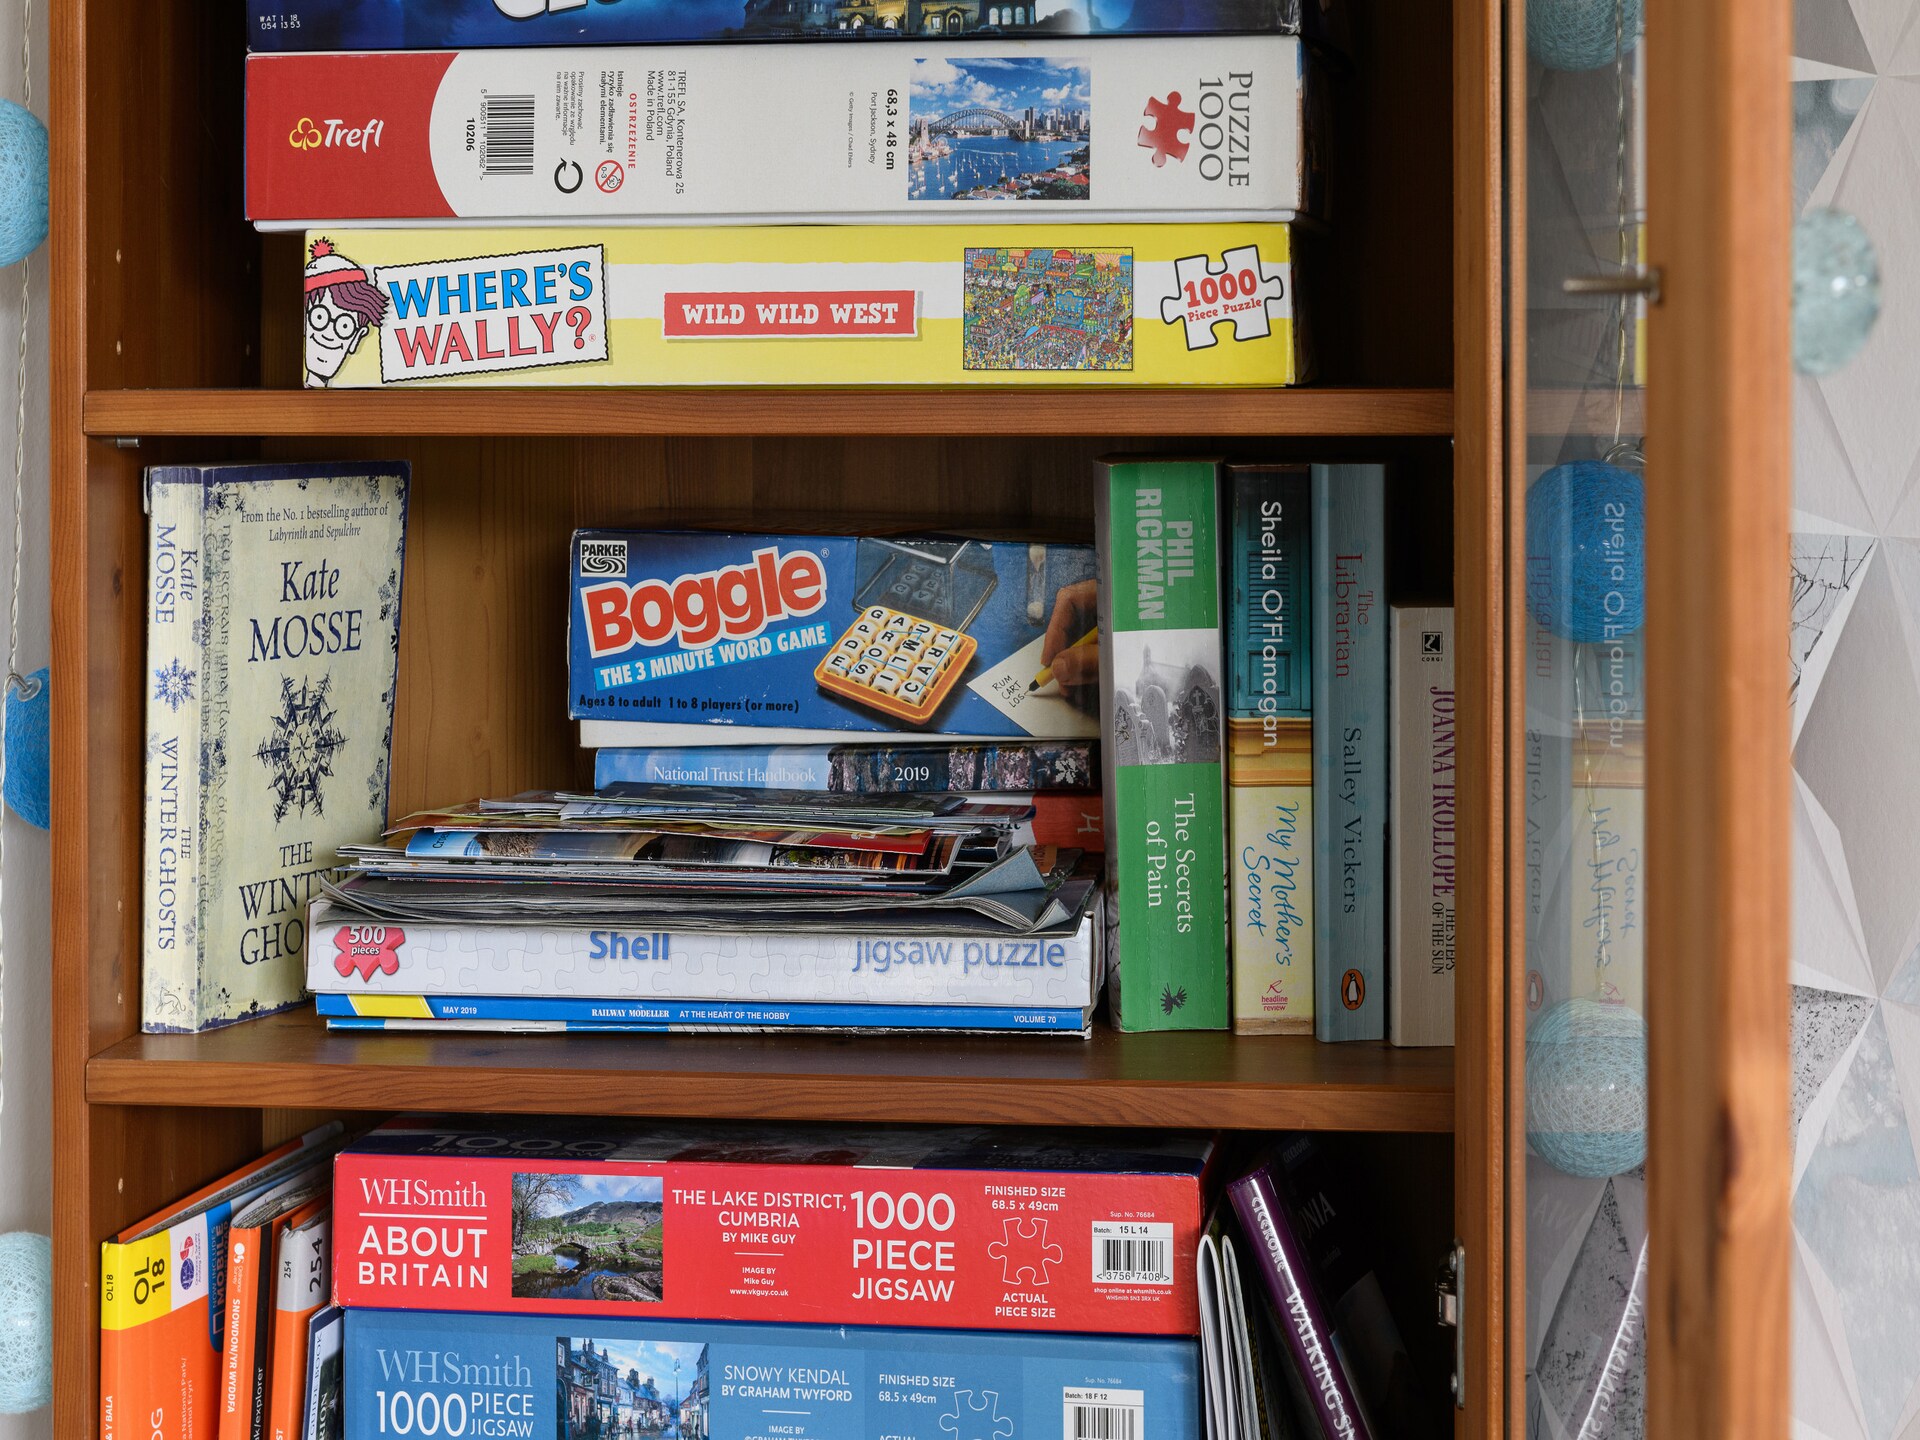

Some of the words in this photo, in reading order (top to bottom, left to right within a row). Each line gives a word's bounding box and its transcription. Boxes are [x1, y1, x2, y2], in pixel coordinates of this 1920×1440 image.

[647, 70, 655, 96] Made
[667, 70, 676, 104] 81-155
[677, 70, 687, 98] TREFL
[647, 98, 655, 107] in
[657, 70, 665, 136] www.trefl.com
[677, 100, 686, 116] SA,
[885, 89, 897, 116] 68,3
[323, 119, 384, 153] Trefl
[466, 117, 475, 151] 10206
[628, 93, 637, 169] OSTRZEŻENIE
[646, 110, 655, 141] Poland
[665, 107, 676, 142] Gdynia,
[869, 107, 877, 136] Jackson,
[1198, 78, 1223, 182] 1000
[1228, 72, 1253, 187] PUZZLE
[676, 119, 685, 179] Kontenerowa
[868, 138, 877, 164] Sydney
[886, 131, 897, 147] 48
[666, 146, 674, 177] Poland
[886, 152, 895, 170] cm
[676, 182, 684, 194] 25
[387, 261, 593, 319] WHERE'S
[1183, 269, 1257, 308] 1000
[682, 304, 745, 324] WILD
[756, 303, 819, 324] WILD
[829, 302, 899, 324] WEST
[1187, 308, 1218, 322] Piece
[1223, 298, 1262, 314] Puzzle
[394, 306, 592, 367] WALLY?
[241, 510, 264, 523] From
[267, 507, 280, 521] the
[283, 508, 298, 520] No.
[307, 504, 350, 523] bestselling
[351, 503, 378, 517] author
[379, 501, 390, 515] of
[269, 526, 308, 544] Labyrinth
[309, 524, 324, 539] and
[326, 523, 361, 541] Sepulchre
[1261, 501, 1282, 580] Sheila
[582, 544, 626, 556] PARKER
[1135, 488, 1164, 620] RICKMAN
[1166, 520, 1194, 586] PHIL
[155, 523, 177, 624] MOSSE
[180, 548, 198, 601] Kate
[280, 559, 340, 602] Kate
[582, 548, 825, 656] Boggle
[1335, 553, 1362, 678] Librarian
[1357, 590, 1373, 625] The
[248, 610, 362, 662] MOSSE
[600, 664, 633, 688] THE
[636, 662, 647, 680] 3
[651, 648, 715, 678] MINUTE
[719, 636, 772, 663] WORD
[777, 625, 826, 652] GAME
[1258, 589, 1283, 746] O'Flanagan
[992, 675, 1013, 691] RUM
[1002, 680, 1021, 699] CART
[579, 694, 606, 708] Ages
[608, 695, 615, 706] 8
[618, 696, 628, 707] to
[633, 696, 661, 708] adult
[669, 697, 673, 708] 1
[676, 697, 688, 709] to
[691, 697, 698, 709] 8
[701, 698, 742, 712] players
[745, 699, 763, 712] (or
[765, 699, 799, 712] more)
[1009, 694, 1025, 707] LOS
[1429, 686, 1454, 775] JOANNA
[653, 766, 709, 782] National
[710, 768, 745, 782] Trust
[747, 768, 816, 782] Handbook
[894, 766, 929, 782] 2019
[1340, 727, 1362, 807] Salley
[160, 736, 179, 844] WINTER
[1174, 793, 1196, 841] The
[1266, 801, 1299, 851] My
[180, 827, 191, 859] THE
[1146, 821, 1167, 849] of
[1432, 783, 1455, 898] TROLLOPE
[279, 841, 313, 868] THE
[1343, 815, 1362, 914] Vickers
[1147, 855, 1167, 908] Pain
[1175, 849, 1196, 933] Secrets
[1243, 846, 1270, 937] Secret
[158, 847, 177, 950] GHOSTS
[1271, 857, 1303, 967] Mother's
[1432, 901, 1444, 920] OF
[348, 927, 386, 944] 500
[589, 931, 670, 960] Shell
[1432, 921, 1444, 945] THE
[351, 945, 380, 956] pieces
[852, 939, 952, 973] jigsaw
[962, 939, 1065, 973] puzzle
[1432, 948, 1444, 975] SUN
[442, 1006, 458, 1015] MAY
[459, 1006, 477, 1015] 2019
[591, 1009, 626, 1017] RAILWAY
[628, 1009, 669, 1018] MODELLER
[679, 1010, 688, 1018] AT
[690, 1010, 704, 1018] THE
[707, 1011, 733, 1019] HEART
[734, 1011, 746, 1019] OF
[747, 1011, 762, 1019] THE
[763, 1012, 790, 1020] HOBBY
[1014, 1015, 1046, 1023] VOLUME
[1047, 1016, 1056, 1024] 70
[359, 1177, 487, 1208] WHSmith
[672, 1190, 706, 1204] THE
[712, 1191, 758, 1207] LAKE
[763, 1192, 847, 1212] DISTRICT,
[984, 1186, 1037, 1197] FINISHED
[1041, 1187, 1066, 1197] SIZE
[991, 1200, 1016, 1210] 68.5
[1028, 1201, 1058, 1211] 49cm
[719, 1211, 800, 1228] CUMBRIA
[850, 1191, 956, 1232] 1000
[358, 1225, 488, 1258] ABOUT
[722, 1233, 737, 1243] BY
[740, 1233, 769, 1243] MIKE
[772, 1234, 796, 1244] GUY
[284, 1260, 292, 1279] 254
[309, 1237, 323, 1293] 254
[853, 1239, 955, 1271] PIECE
[106, 1274, 114, 1302] OL18
[134, 1256, 150, 1305] OL
[152, 1258, 165, 1293] 18
[359, 1262, 488, 1289] BRITAIN
[852, 1277, 955, 1302] JIGSAW
[729, 1288, 789, 1297] www.vkguy.co.uk
[1003, 1293, 1048, 1304] ACTUAL
[995, 1307, 1029, 1317] PIECE
[1031, 1308, 1056, 1318] SIZE
[228, 1299, 241, 1369] SNOWDON/YR
[1286, 1288, 1343, 1411] WALKING
[376, 1349, 533, 1388] WHSmith
[724, 1365, 783, 1382] SNOWY
[788, 1368, 850, 1385] KENDAL
[227, 1371, 237, 1413] WYDDFA
[471, 1392, 534, 1416] PIECE
[721, 1385, 735, 1396] BY
[739, 1386, 790, 1399] GRAHAM
[794, 1388, 852, 1402] TWYFORD
[376, 1390, 467, 1437] 1000
[470, 1418, 534, 1439] JIGSAW
